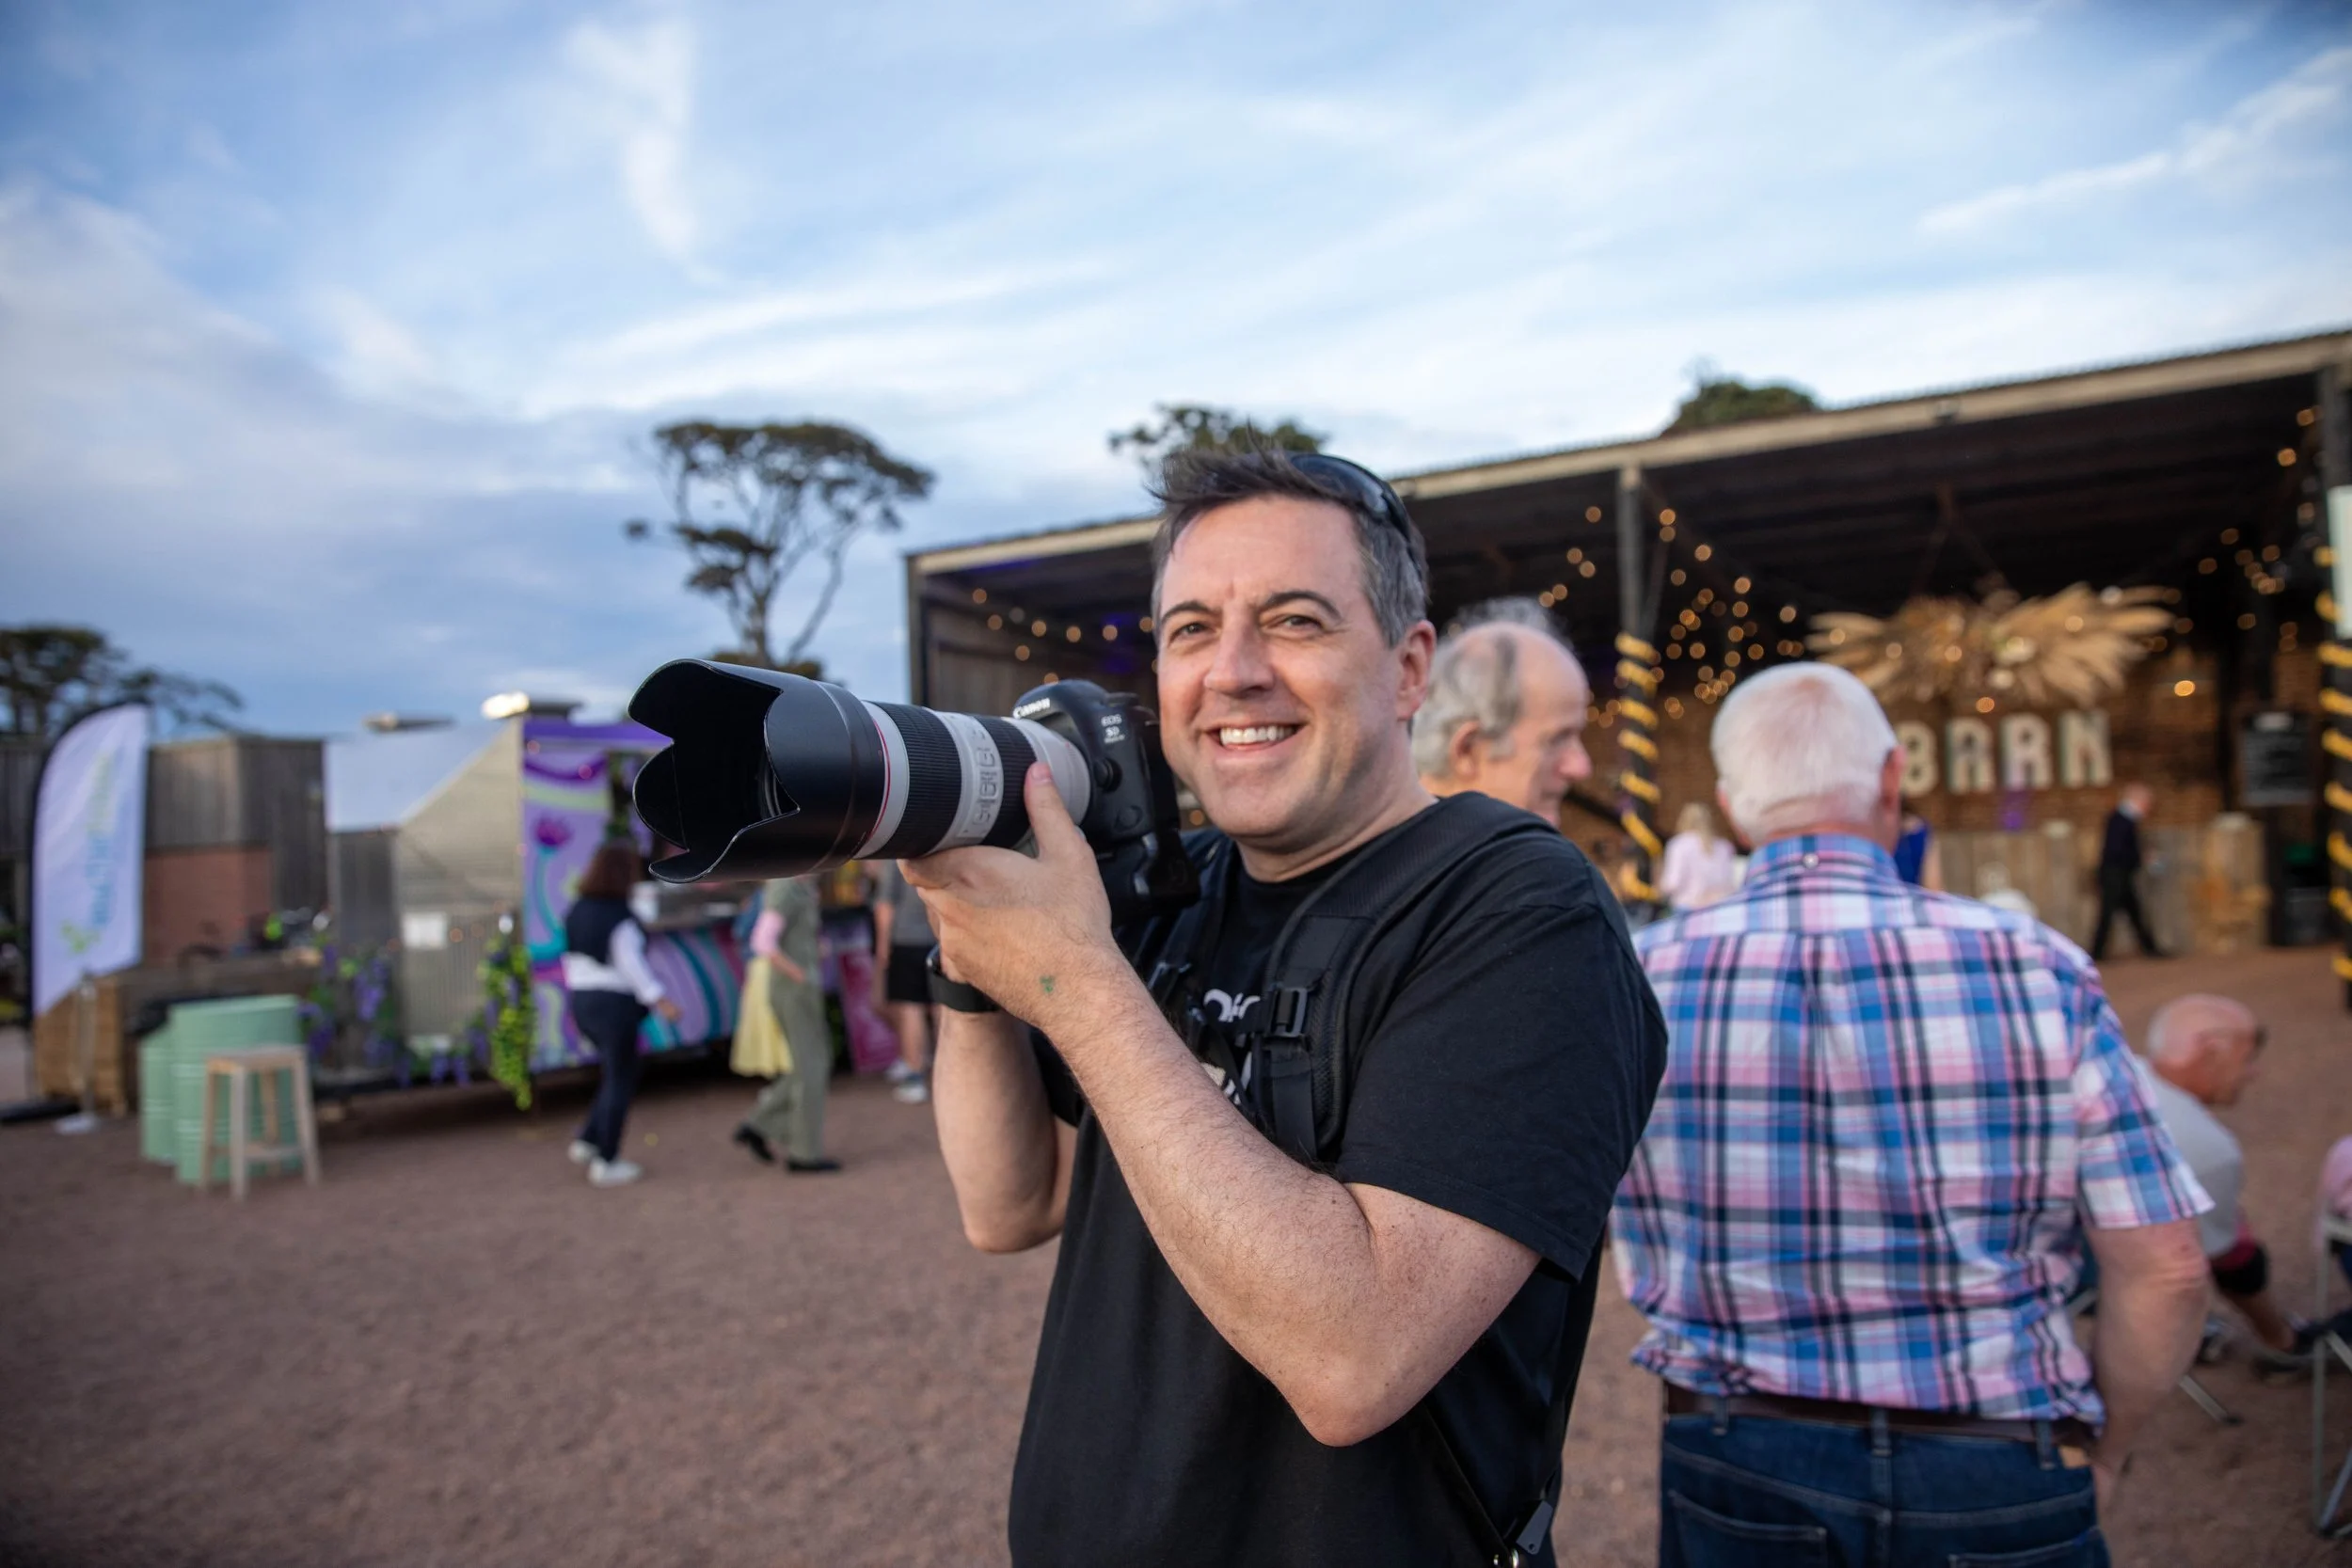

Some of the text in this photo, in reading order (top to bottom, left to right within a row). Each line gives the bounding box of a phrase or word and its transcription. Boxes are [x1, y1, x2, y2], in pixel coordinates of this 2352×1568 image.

[1012, 697, 1051, 719] Canon
[1101, 714, 1122, 727] EOS
[1897, 710, 2113, 797] BARN
